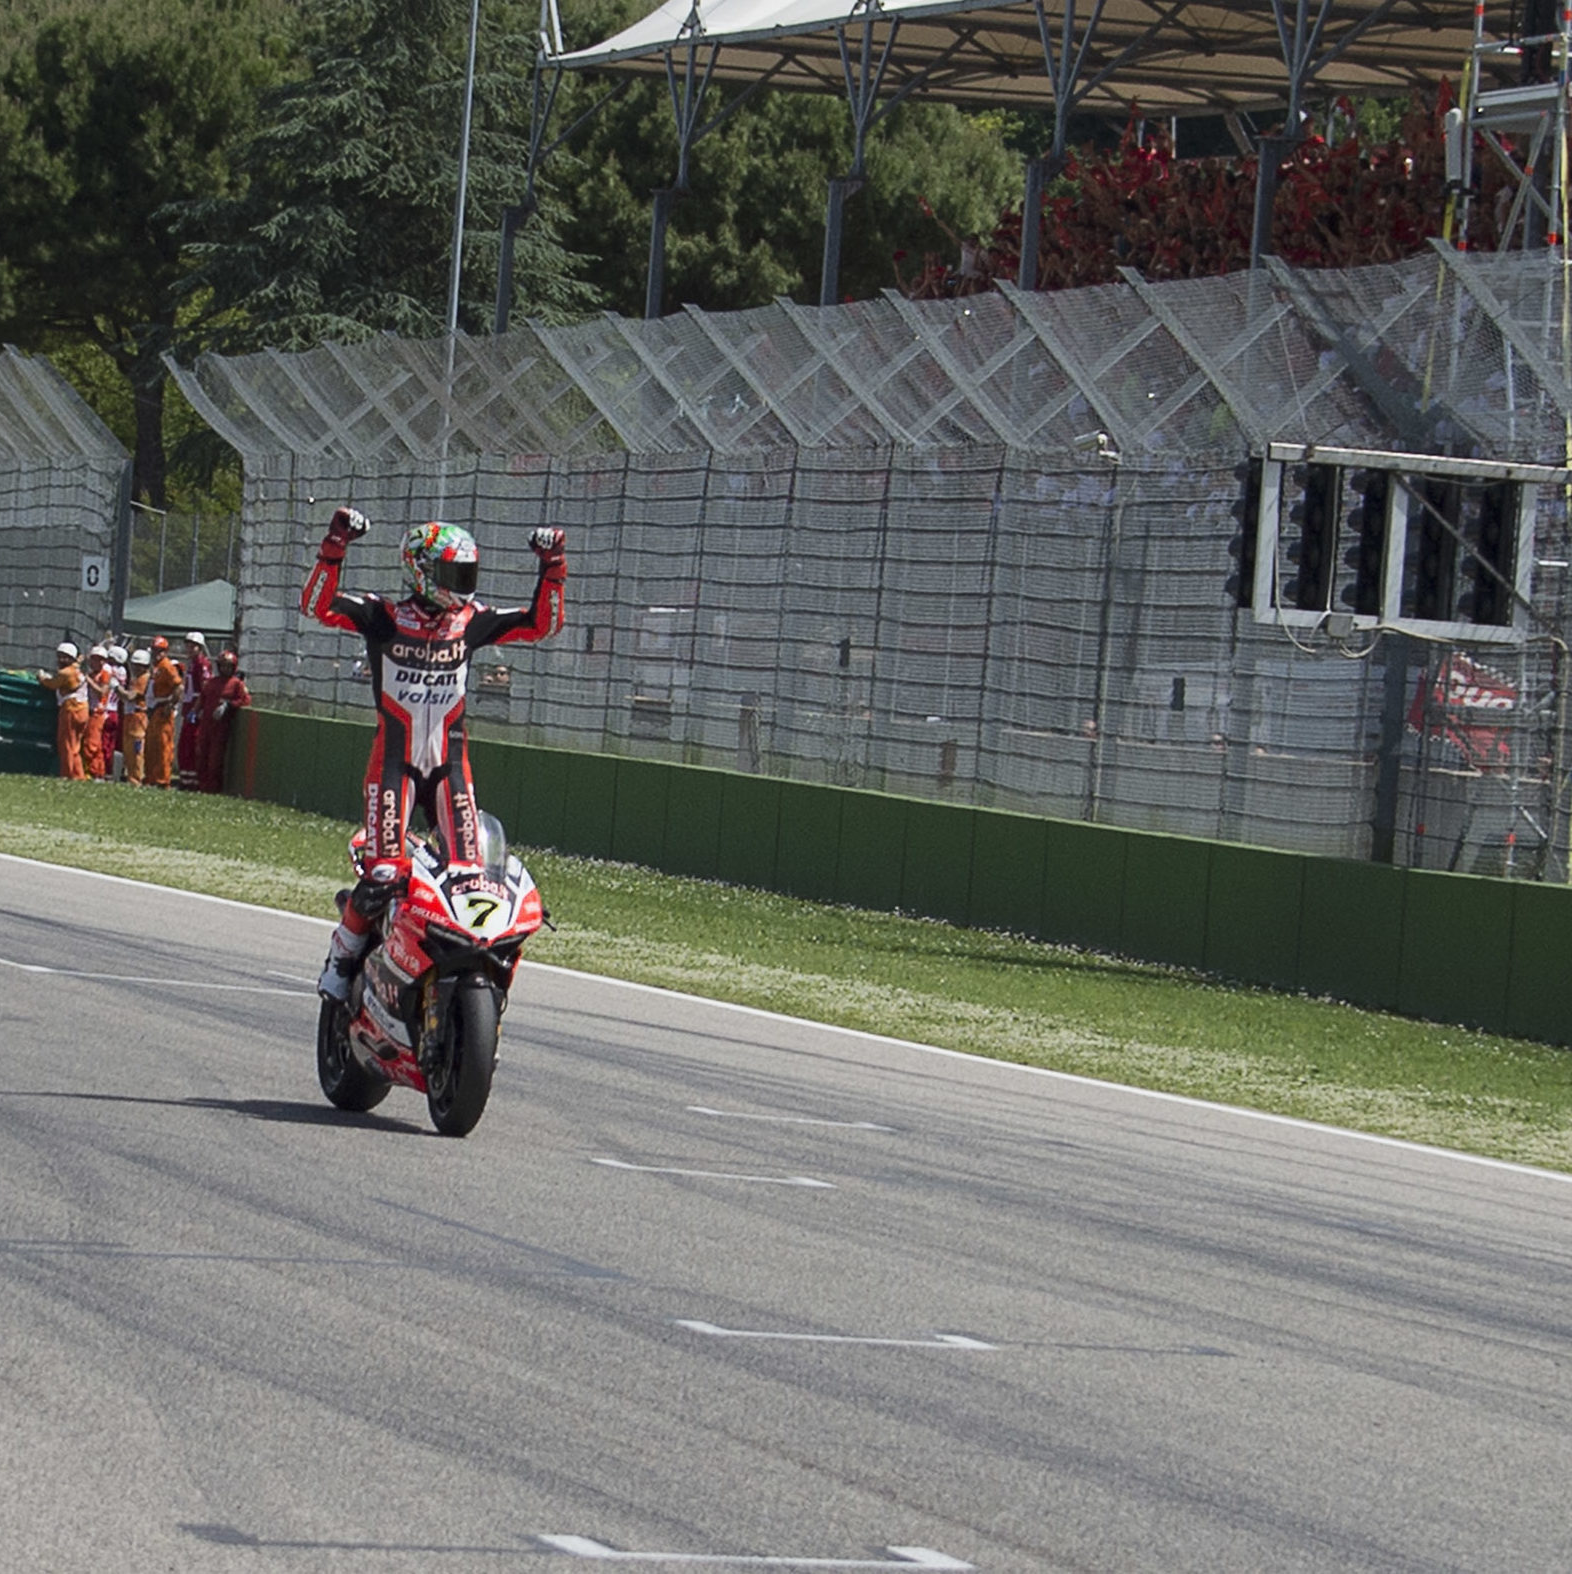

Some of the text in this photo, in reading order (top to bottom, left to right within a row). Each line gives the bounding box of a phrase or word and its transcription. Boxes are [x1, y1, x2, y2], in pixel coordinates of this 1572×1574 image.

[395, 670, 458, 687] DUCATI
[397, 688, 455, 705] valsir
[366, 783, 379, 859] DUCATI
[382, 790, 401, 858] aruba.it
[466, 897, 499, 929] 7
